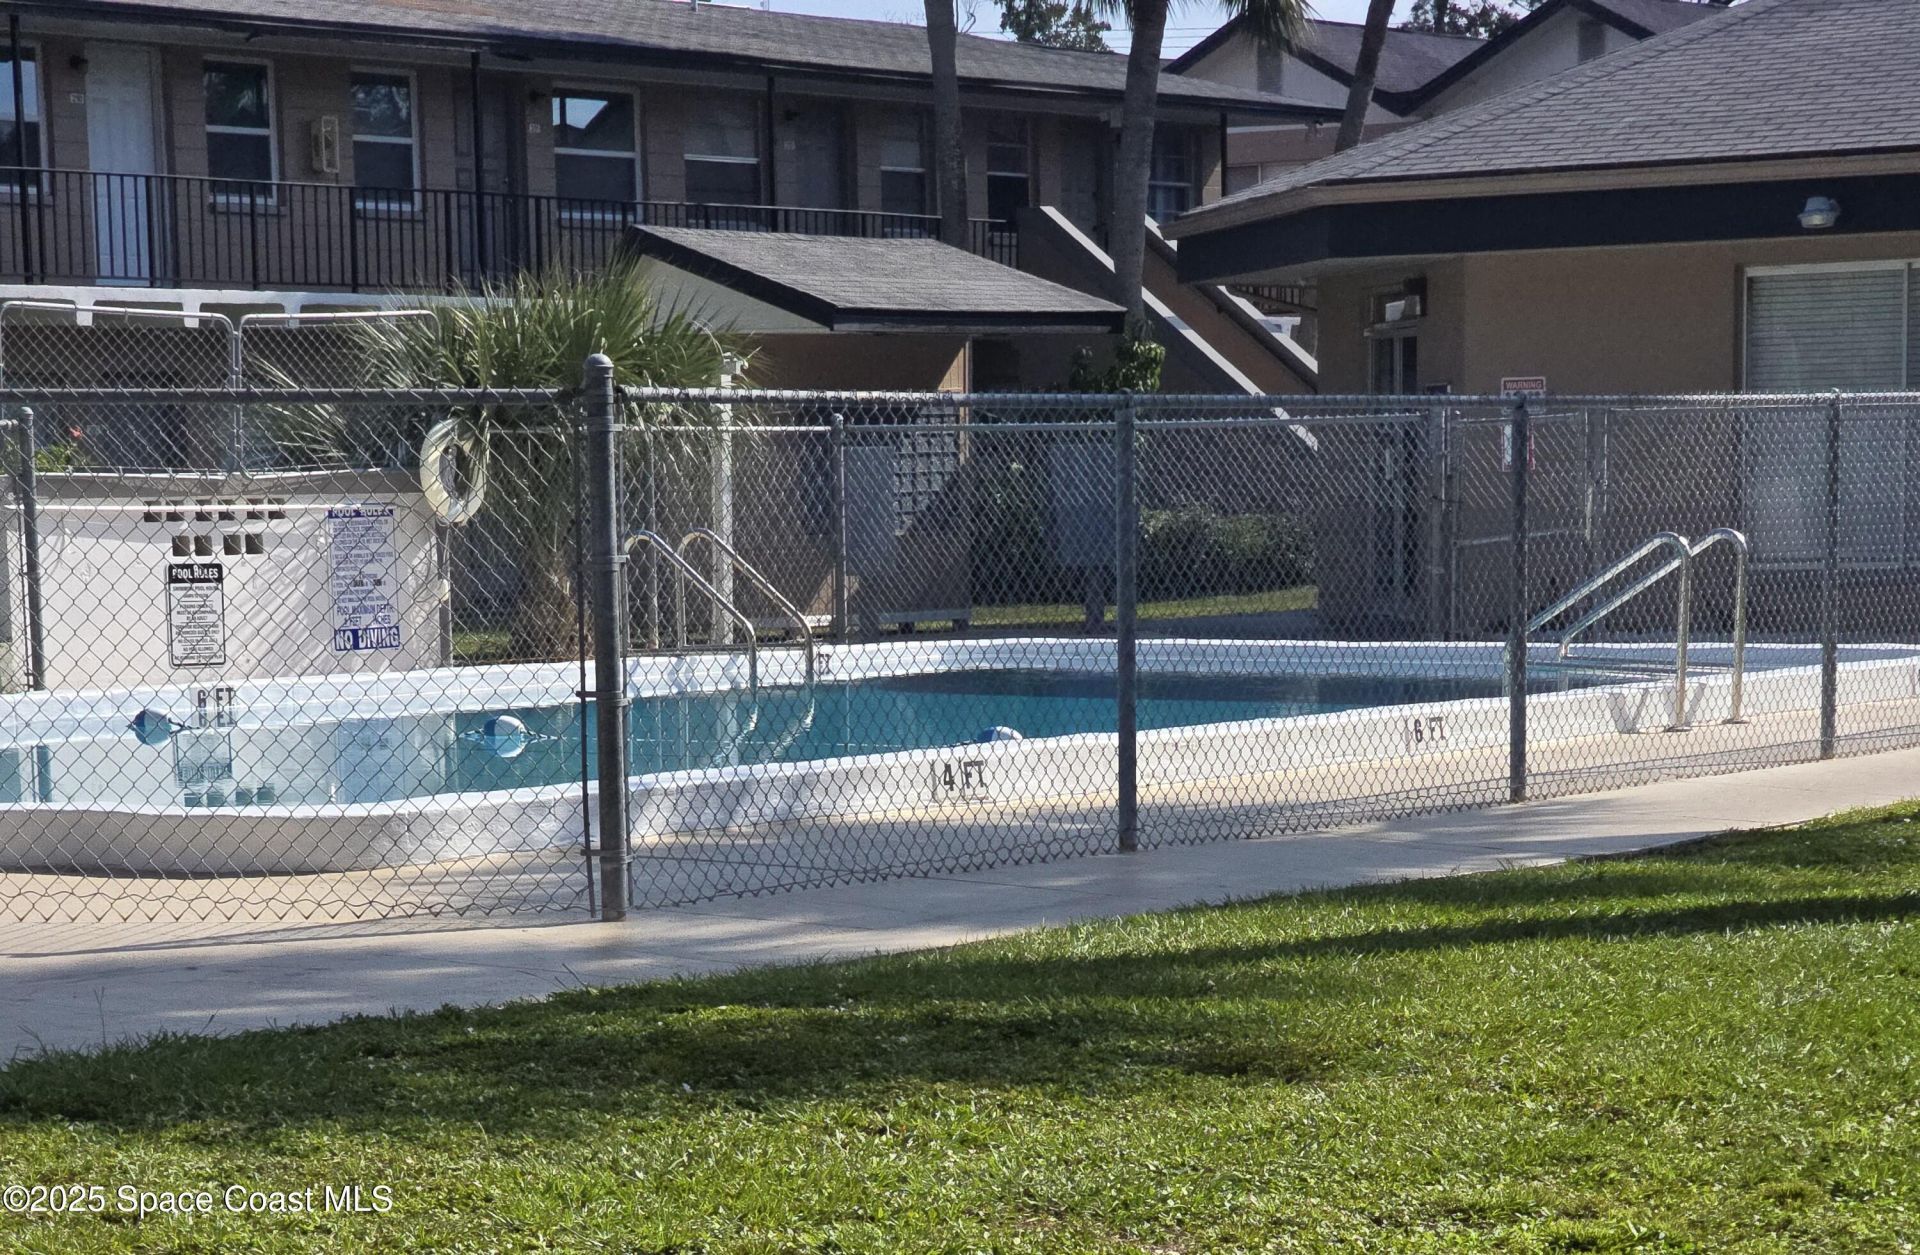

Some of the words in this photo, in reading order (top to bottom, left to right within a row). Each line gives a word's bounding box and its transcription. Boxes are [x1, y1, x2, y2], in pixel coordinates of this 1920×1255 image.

[1505, 381, 1542, 389] WARNING
[172, 568, 192, 578] POOL
[193, 565, 218, 578] RULES
[336, 630, 353, 649] NO
[358, 628, 399, 649] DIVING
[198, 689, 207, 708] 6
[215, 688, 234, 708] FT
[1414, 719, 1424, 743] 6
[1428, 717, 1445, 741] FT
[943, 763, 955, 791] 4
[963, 760, 985, 789] FT
